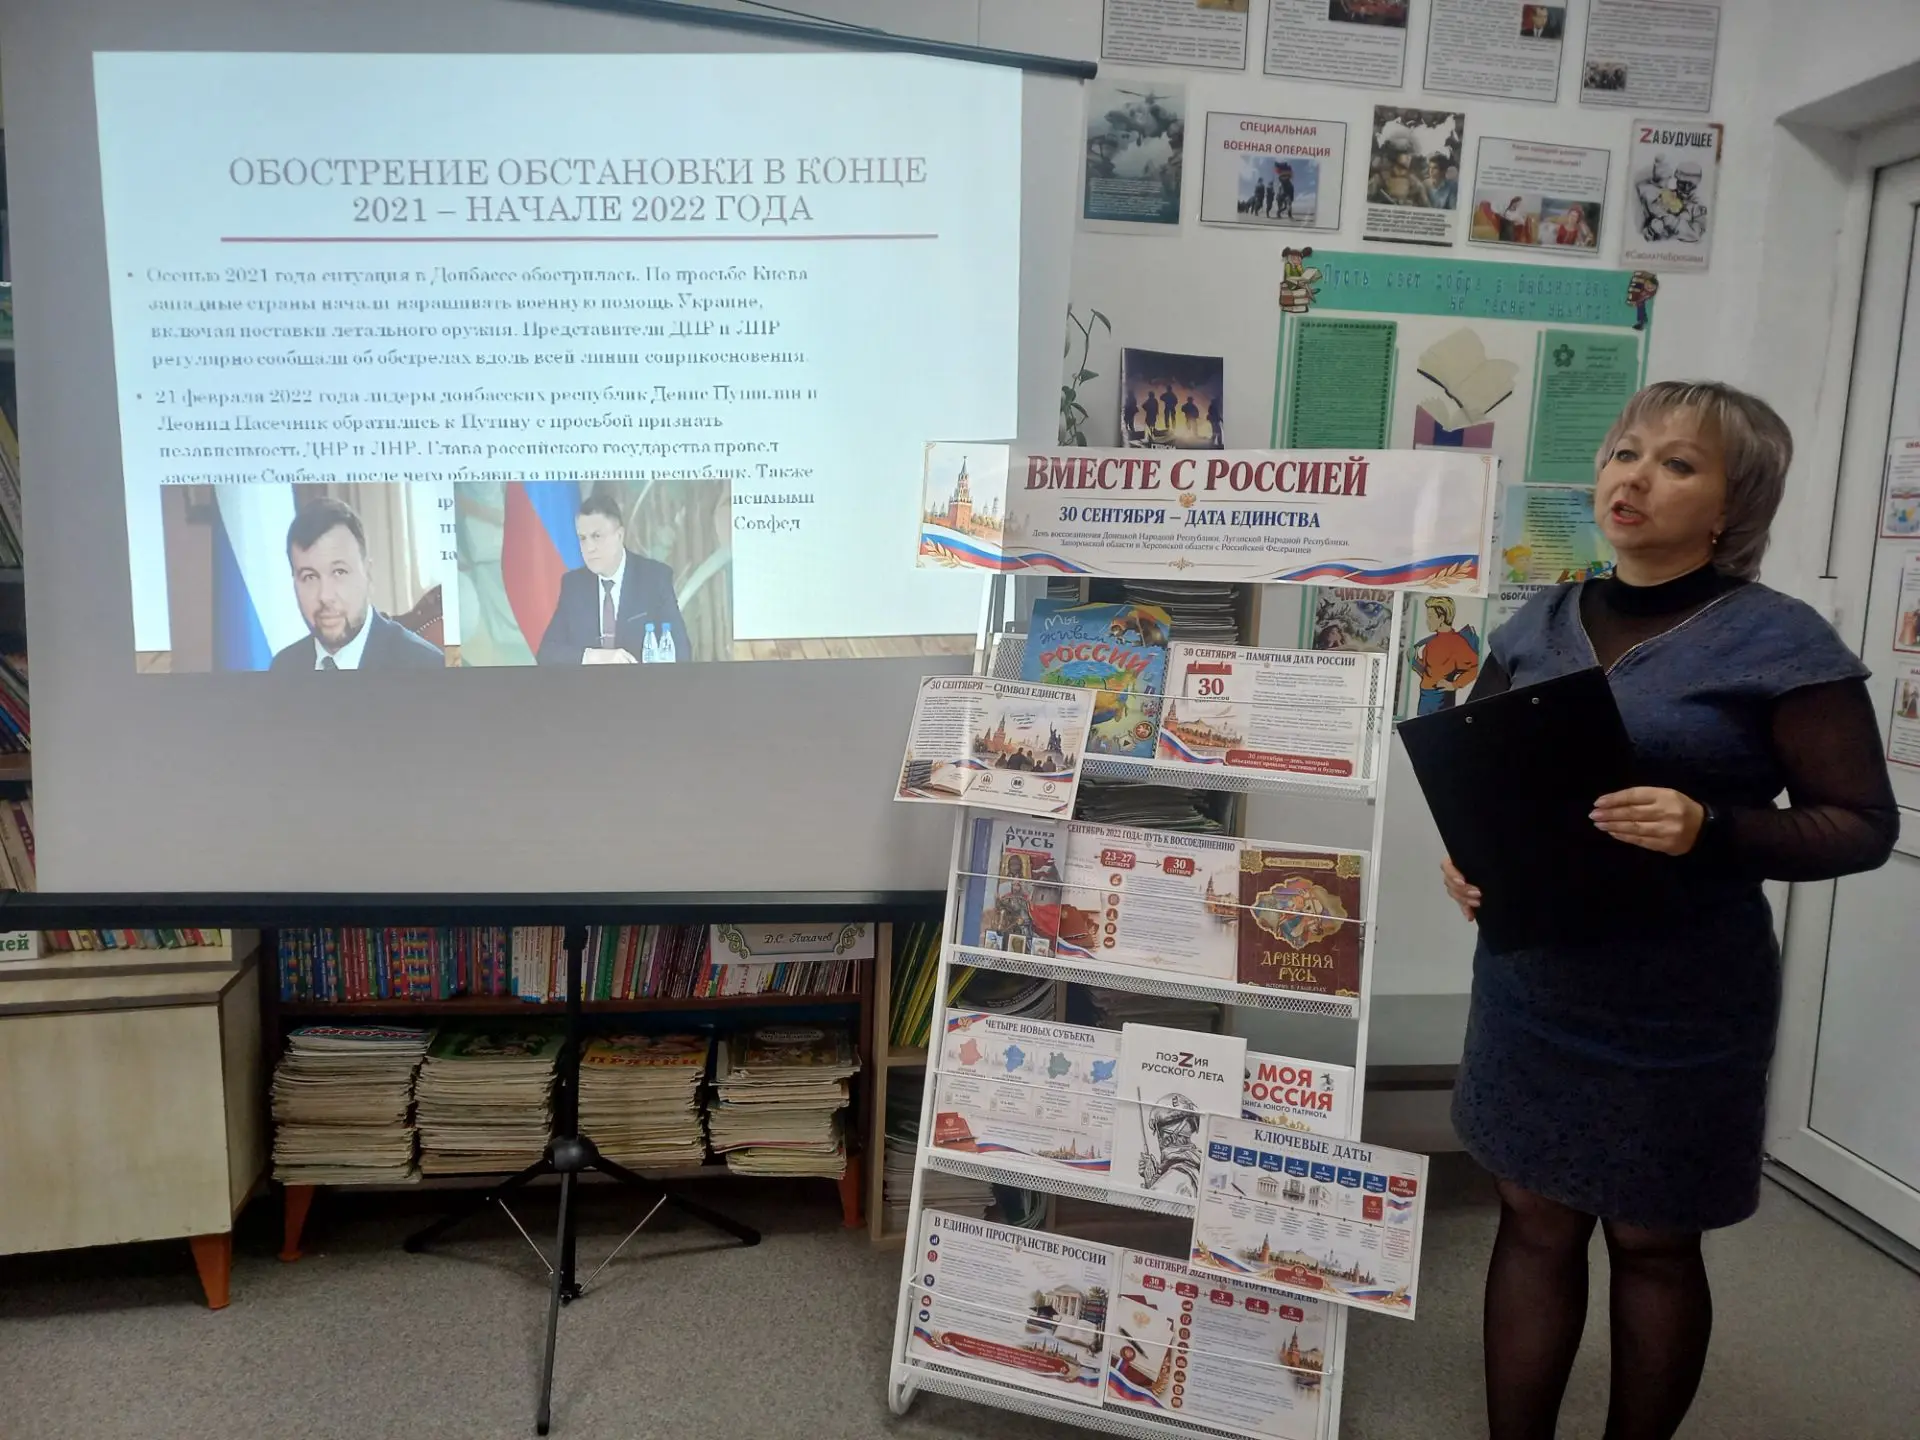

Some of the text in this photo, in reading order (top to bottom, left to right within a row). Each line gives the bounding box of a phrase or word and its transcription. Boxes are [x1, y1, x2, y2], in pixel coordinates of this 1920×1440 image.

[1239, 120, 1317, 136] СПЕЦИАЛЬНАЯ
[1223, 140, 1331, 157] ВОЕННАЯ ОПЕРАЦИЯ
[230, 156, 928, 187] ОБОСТРЕНИЕ ОБСТАНОВКИ В КОНЦЕ
[353, 195, 813, 226] 2021 НАЧАЛЕ 2022 ГОДА
[147, 267, 220, 283] Осенью
[225, 268, 268, 283] 2021
[275, 270, 316, 285] года
[322, 269, 409, 285] ситуация
[430, 266, 517, 286] Донбассе
[521, 266, 639, 285] обострилась.
[646, 266, 670, 282] По
[676, 266, 746, 283] просьбе
[753, 266, 808, 281] Киева
[247, 297, 316, 315] страны
[322, 297, 389, 311] начали
[397, 297, 511, 314] наращивать
[516, 296, 596, 311] военную
[601, 295, 673, 312] помощь
[678, 293, 763, 311] Украине,
[151, 324, 236, 338] включая
[240, 324, 326, 337] поставки
[331, 322, 436, 337] летального
[442, 323, 517, 340] оружия.
[523, 320, 665, 340] Представители
[152, 352, 257, 369] регулярно
[260, 348, 348, 366] сообщали
[353, 347, 373, 365] об
[378, 347, 470, 368] обстрелах
[476, 350, 529, 367] вдоль
[534, 348, 575, 365] всей
[155, 390, 177, 404] 21
[182, 390, 264, 407] февраля
[269, 390, 312, 404] 2022
[319, 391, 359, 406] года
[363, 391, 435, 407] лидеры
[440, 387, 544, 405] донбасских
[551, 387, 648, 405] республик
[651, 386, 708, 405] Денис
[158, 413, 723, 432] Леонид Пасечник обратились к Путину с просьбой признать
[303, 442, 348, 459] ДНР
[353, 445, 365, 457] и
[426, 441, 482, 456] Глава
[487, 441, 598, 458] российского
[603, 442, 710, 458] государства
[714, 440, 779, 457] провел
[755, 464, 814, 480] Также
[1024, 455, 1370, 497] ВМЕСТЕ С РОССИЕЙ
[734, 515, 801, 533] Совфед
[1059, 506, 1321, 528] 30 СЕНТЯБРЯ ДАТА ЕДИНСТВА
[1102, 531, 1138, 541] Донецкой
[1139, 532, 1175, 542] Народной
[1263, 535, 1301, 545] Народной
[1221, 543, 1264, 553] Российской
[1044, 614, 1079, 631] Мы
[1039, 642, 1153, 673] РОССИИ
[1183, 648, 1356, 667] 30 СЕНТЯБРЯ ПАМЯТНАЯ ДАТА РОССИИ
[931, 680, 1076, 702] 30 СЕНТЯБРЯ СИМВОЛ ЕДИНСТВА
[1198, 678, 1224, 696] 30
[1005, 834, 1054, 849] РУСЬ
[1067, 824, 1236, 852] СЕНТЯБРЬ 2022 ГОДА: ПУТЬ К ВОССОЕДИНЕНИЮ
[1173, 859, 1186, 870] 30
[1261, 951, 1334, 969] ДРЕВНЯЯ
[1279, 967, 1317, 983] РУСЬ
[985, 1019, 1095, 1044] ЧЕТЫРЕ НОВЫХ СУБЪЕКТА
[1141, 1062, 1225, 1084] РУССКОГО ЛЕТА
[1258, 1063, 1312, 1088] МОЯ
[1264, 1103, 1290, 1113] ЮНОГО
[1292, 1108, 1327, 1119] ПАТРИОТА
[1254, 1129, 1373, 1164] КЛЮЧЕВЫЕ ДАТЫ
[934, 1216, 1106, 1266] В ЕДИНОМ ПРОСТРАНСТВЕ РОССИИ
[1133, 1254, 1143, 1265] 30
[1144, 1257, 1187, 1274] СЕНТЯБРЯ
